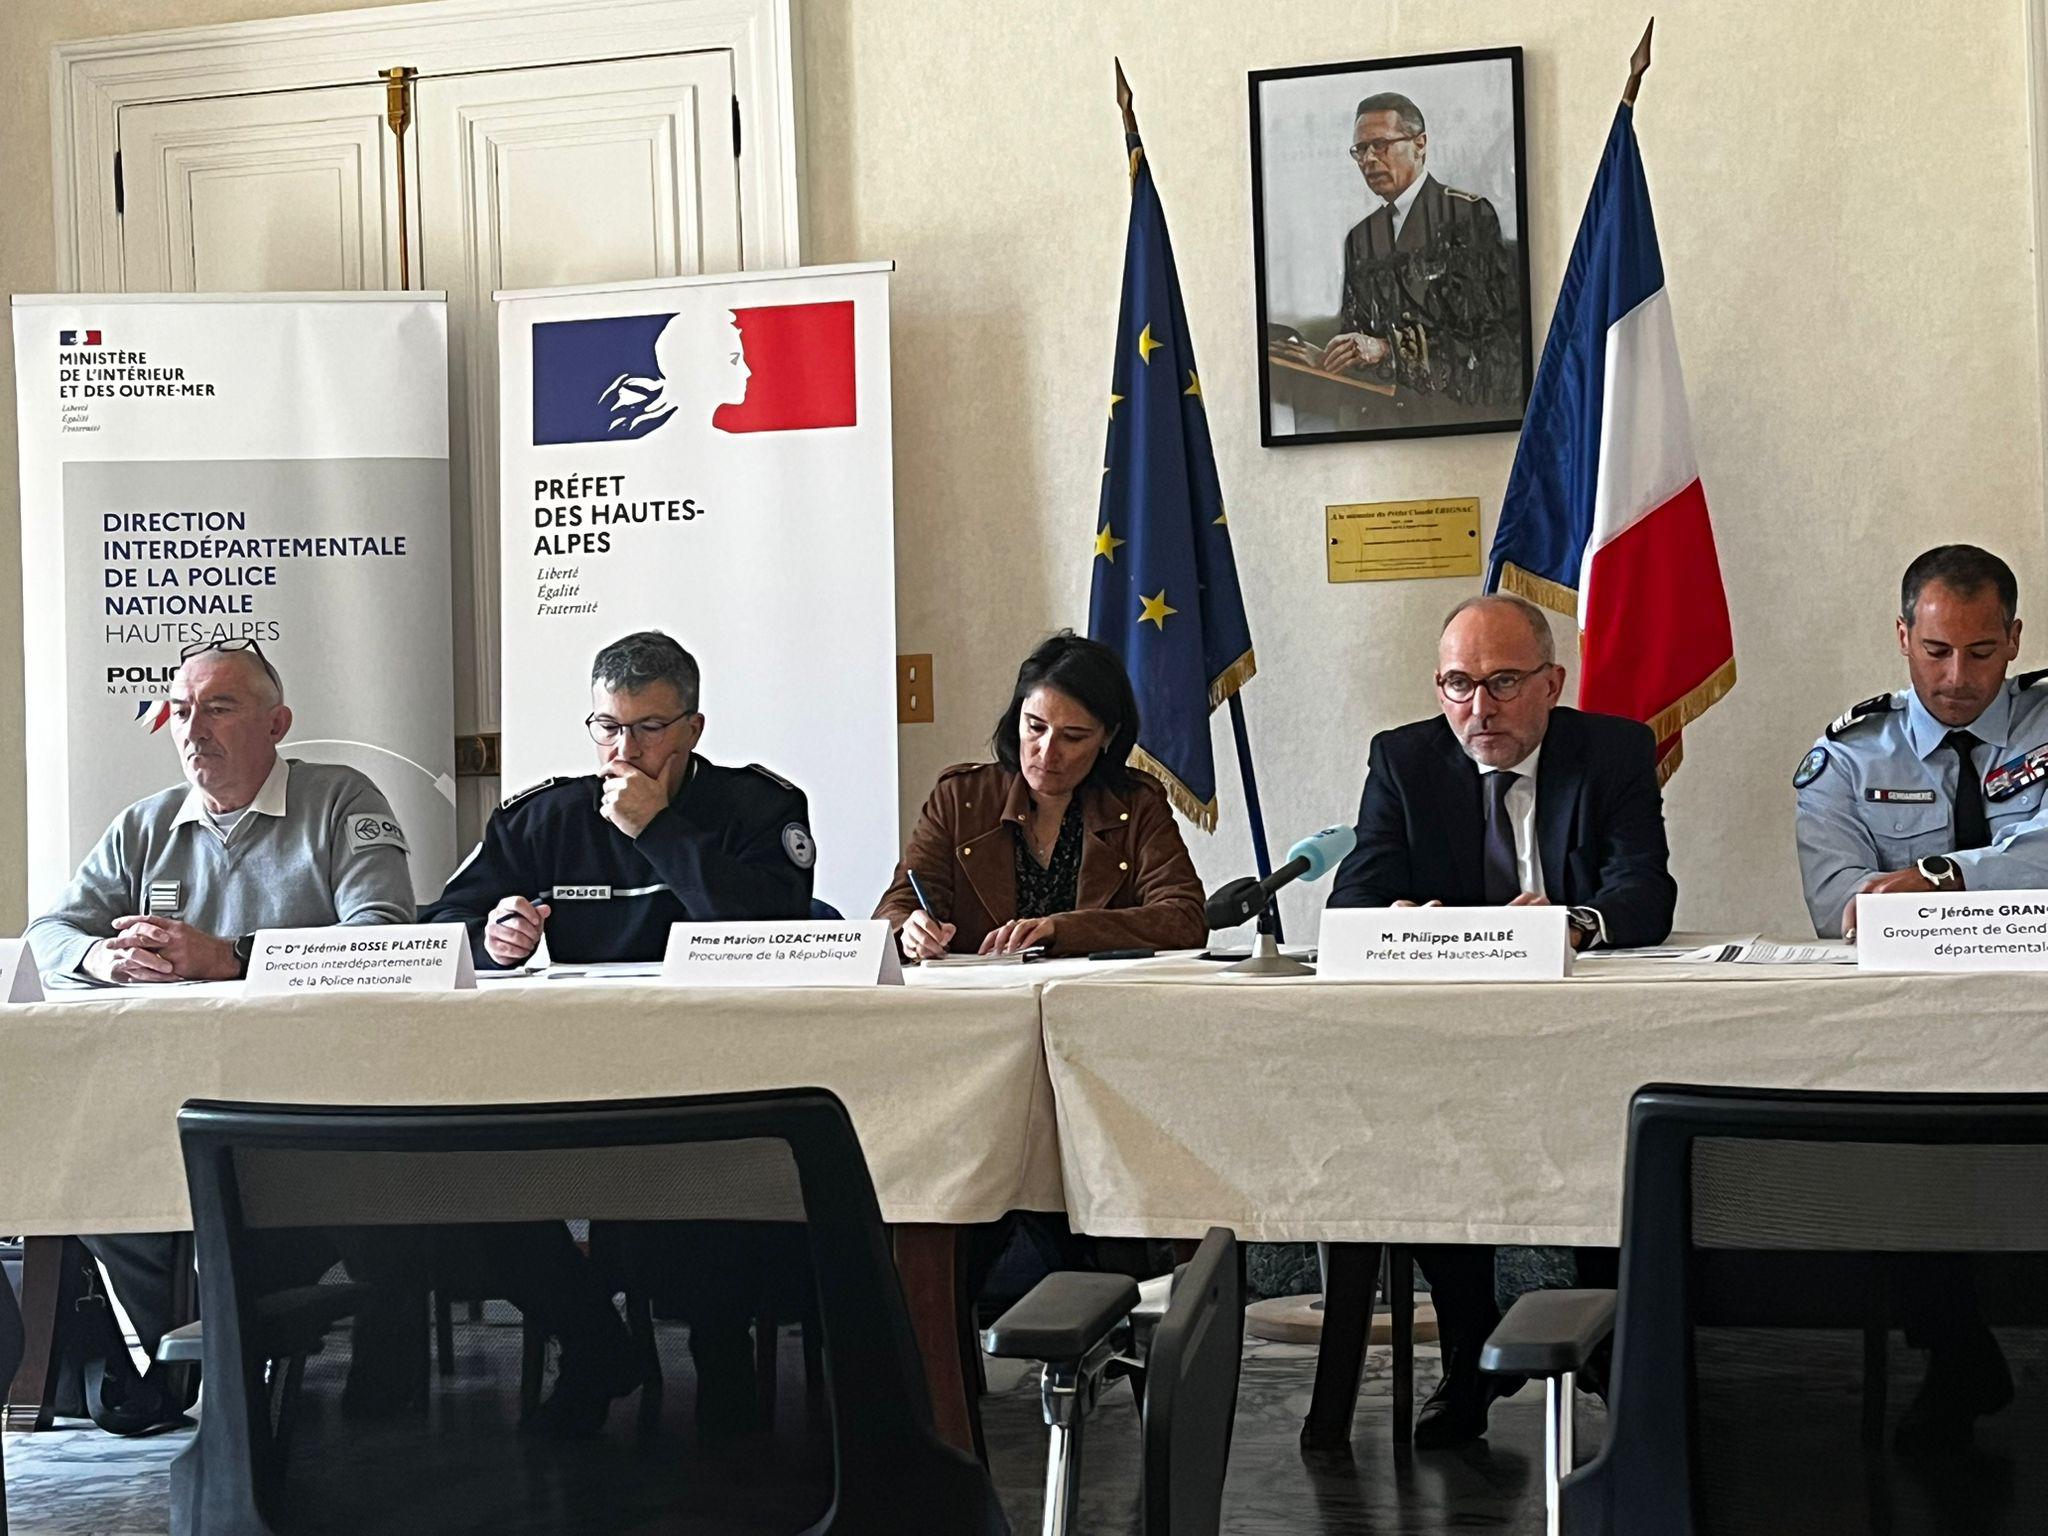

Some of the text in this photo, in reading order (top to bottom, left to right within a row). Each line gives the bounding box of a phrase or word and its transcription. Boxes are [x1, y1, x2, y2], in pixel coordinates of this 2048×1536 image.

[59, 350, 147, 365] MINISTÈRE
[60, 366, 185, 382] DE L'INTÉRIEUR
[60, 384, 215, 398] ET DES OUTRE-MER
[534, 472, 625, 500] PRÉFET
[103, 511, 246, 532] DIRECTION
[535, 499, 705, 528] DES HAUTES-
[104, 535, 406, 560] INTERDÉPARTEMENTALE
[534, 531, 610, 556] ALPES
[105, 566, 277, 588] DE LA POLICE
[537, 567, 579, 580] Liberté
[537, 584, 580, 600] Égalité
[105, 594, 253, 615] NATIONALE
[537, 601, 598, 616] Fraternité
[106, 621, 280, 643] HAUTES-ALPES
[107, 667, 181, 683] POLIC
[107, 685, 169, 694] NATION
[556, 889, 607, 897] POLICE
[1941, 906, 1994, 920] Jérôme
[1998, 905, 2048, 917] GRAN
[1381, 928, 1514, 945] M. Philippe BAILBÉ
[1883, 925, 1978, 939] Groupement
[1983, 924, 2001, 935] de
[302, 943, 347, 955] Jérémie
[350, 941, 388, 952] BOSSE
[392, 938, 448, 950] PLATIÈRE
[690, 936, 720, 945] Mme
[723, 935, 766, 945] Marion
[688, 949, 858, 961] Procureure de la République
[1366, 948, 1528, 961] Préfet des Hautes-Alpes
[1934, 941, 2048, 957] départemental
[266, 957, 443, 971] Direction interdépartementale
[289, 974, 412, 986] de la Police nationale
